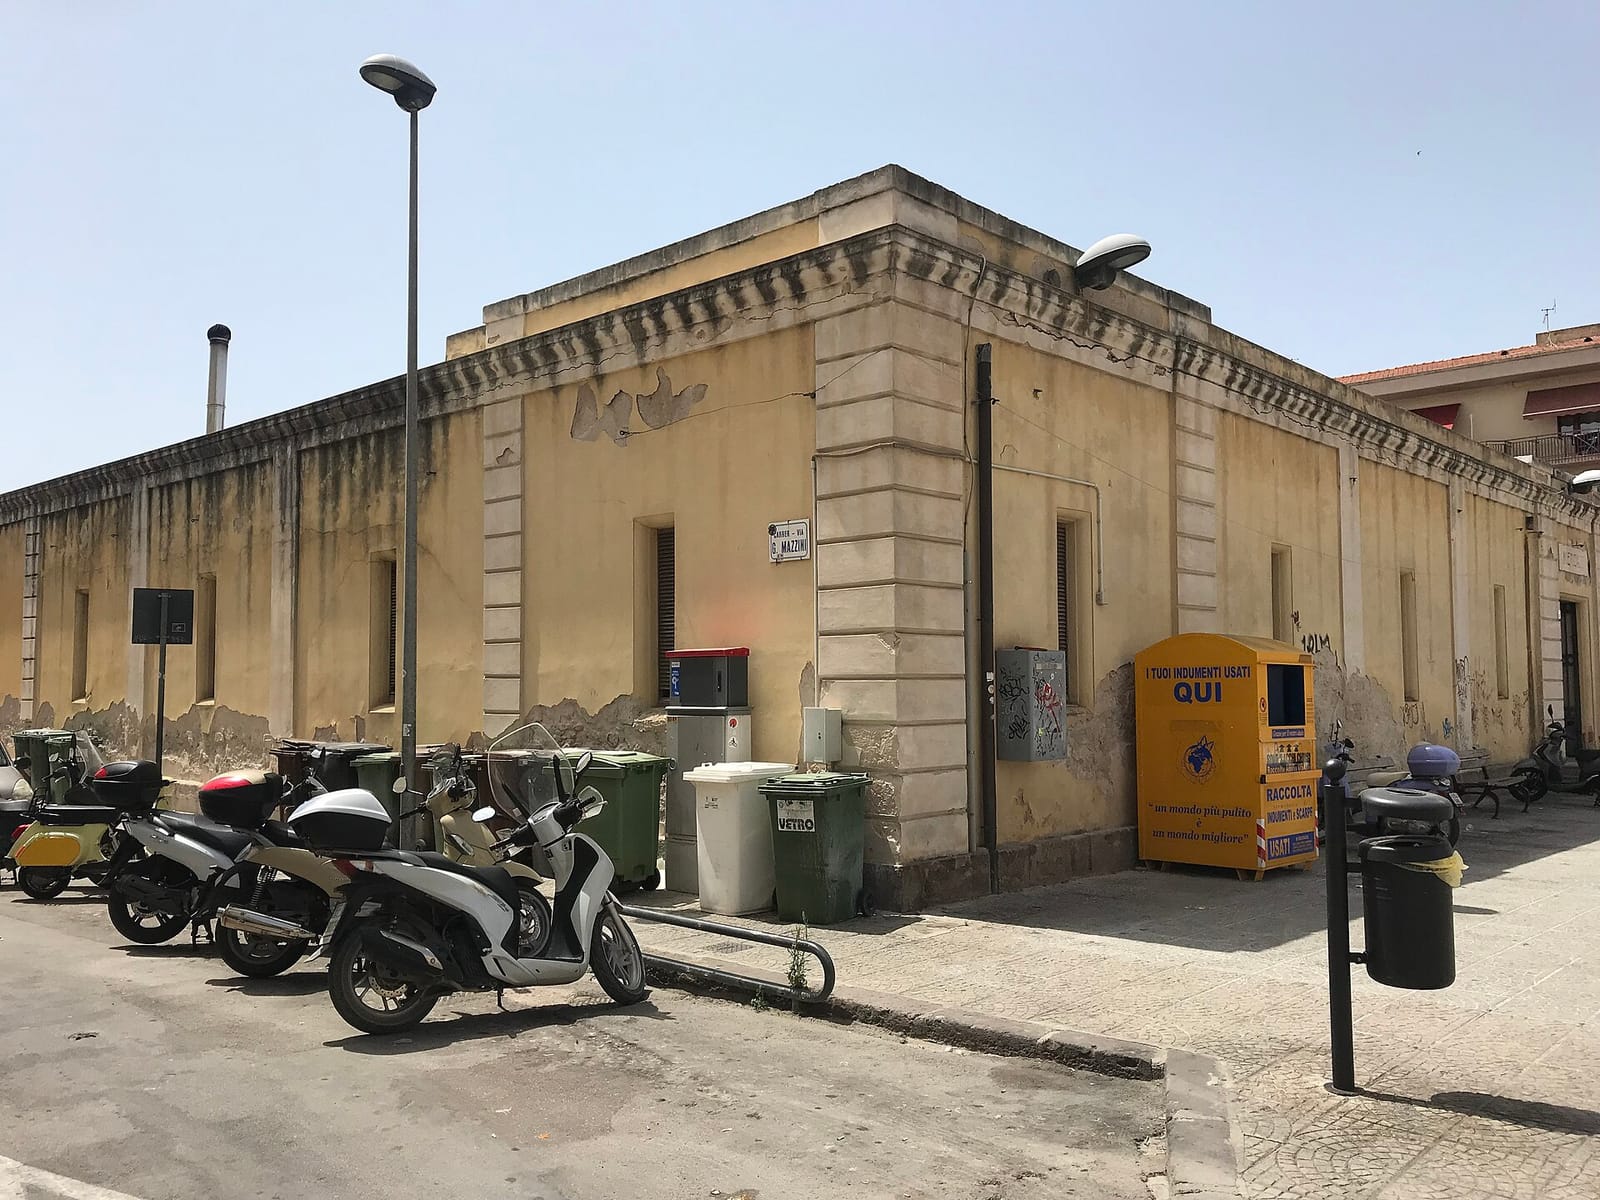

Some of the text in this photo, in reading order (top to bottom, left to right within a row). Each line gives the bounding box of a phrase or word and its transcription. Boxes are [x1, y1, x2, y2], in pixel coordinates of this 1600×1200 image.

[781, 538, 807, 554] MAZZINI
[1146, 665, 1251, 679] I TUOI INDUMENTI USATI
[1173, 681, 1222, 704] QUI
[1266, 785, 1312, 801] RACCOLTA
[1169, 804, 1202, 815] mondo
[1221, 807, 1252, 818] pulito
[1267, 808, 1293, 824] INDUMENTI
[1296, 806, 1313, 819] SCARPE
[778, 818, 814, 830] VETRO
[1152, 829, 1165, 837] un
[1167, 830, 1200, 841] mondo
[1269, 837, 1291, 857] USATI
